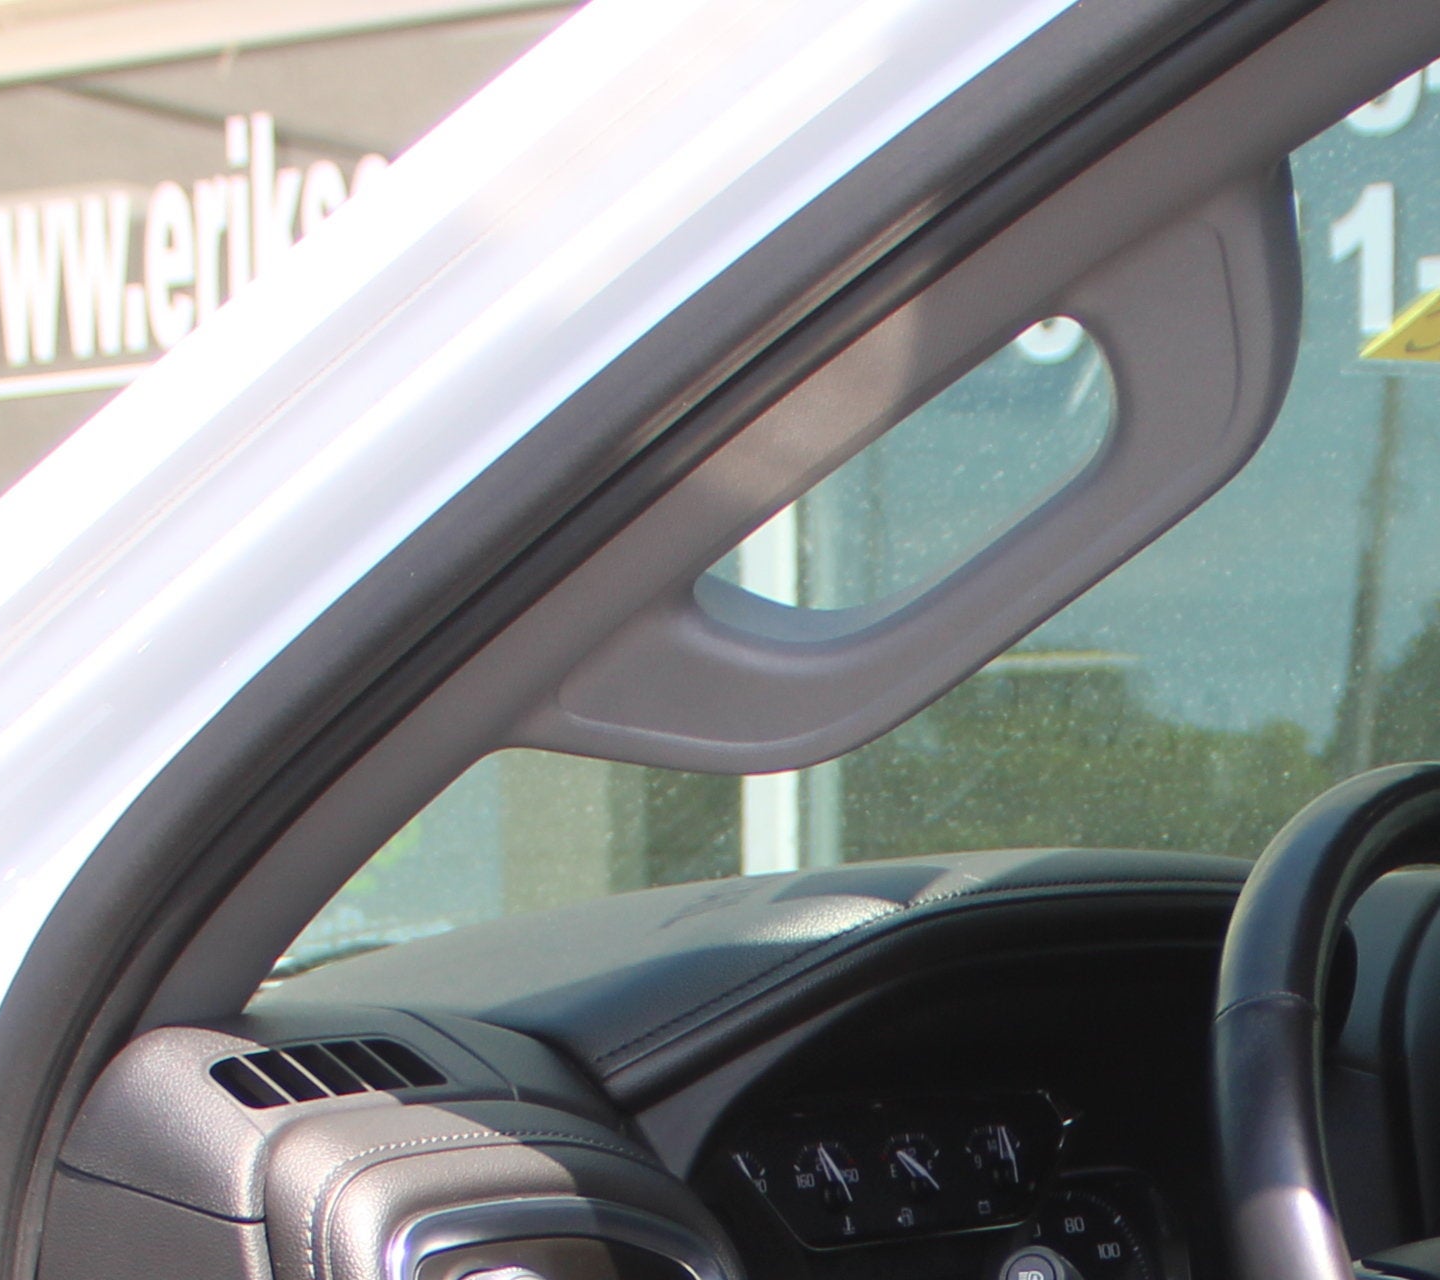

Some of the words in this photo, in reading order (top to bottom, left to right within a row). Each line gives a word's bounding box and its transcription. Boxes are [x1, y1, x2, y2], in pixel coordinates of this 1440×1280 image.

[890, 1162, 897, 1178] E
[1064, 1216, 1086, 1234] 80
[1097, 1242, 1122, 1260] 100
